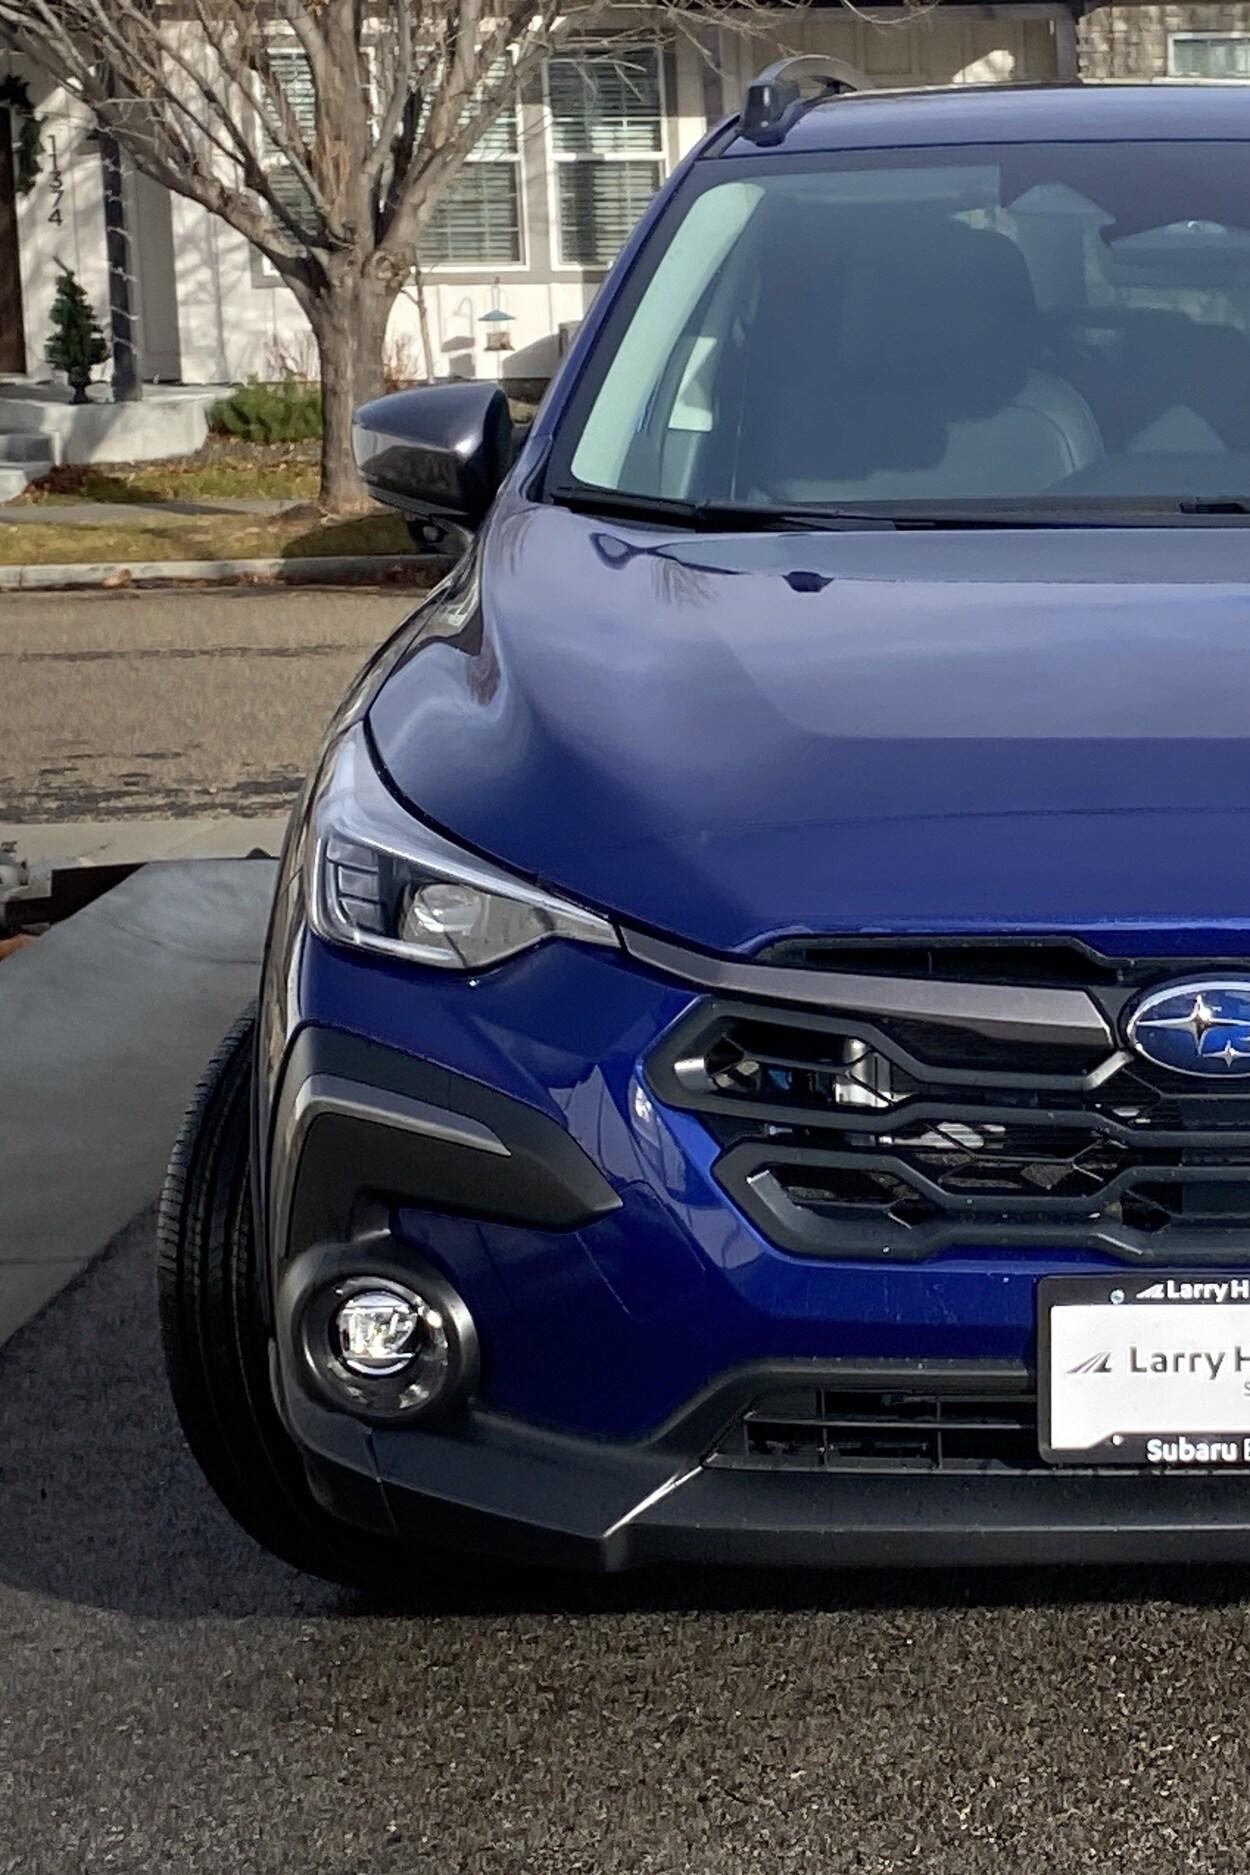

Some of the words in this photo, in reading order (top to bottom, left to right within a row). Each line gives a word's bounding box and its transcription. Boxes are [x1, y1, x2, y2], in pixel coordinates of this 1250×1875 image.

[47, 134, 64, 227] 11374
[1166, 1279, 1229, 1303] Larry
[1230, 1279, 1250, 1299] H
[1129, 1345, 1226, 1381] Larry
[1146, 1436, 1238, 1463] Subaru
